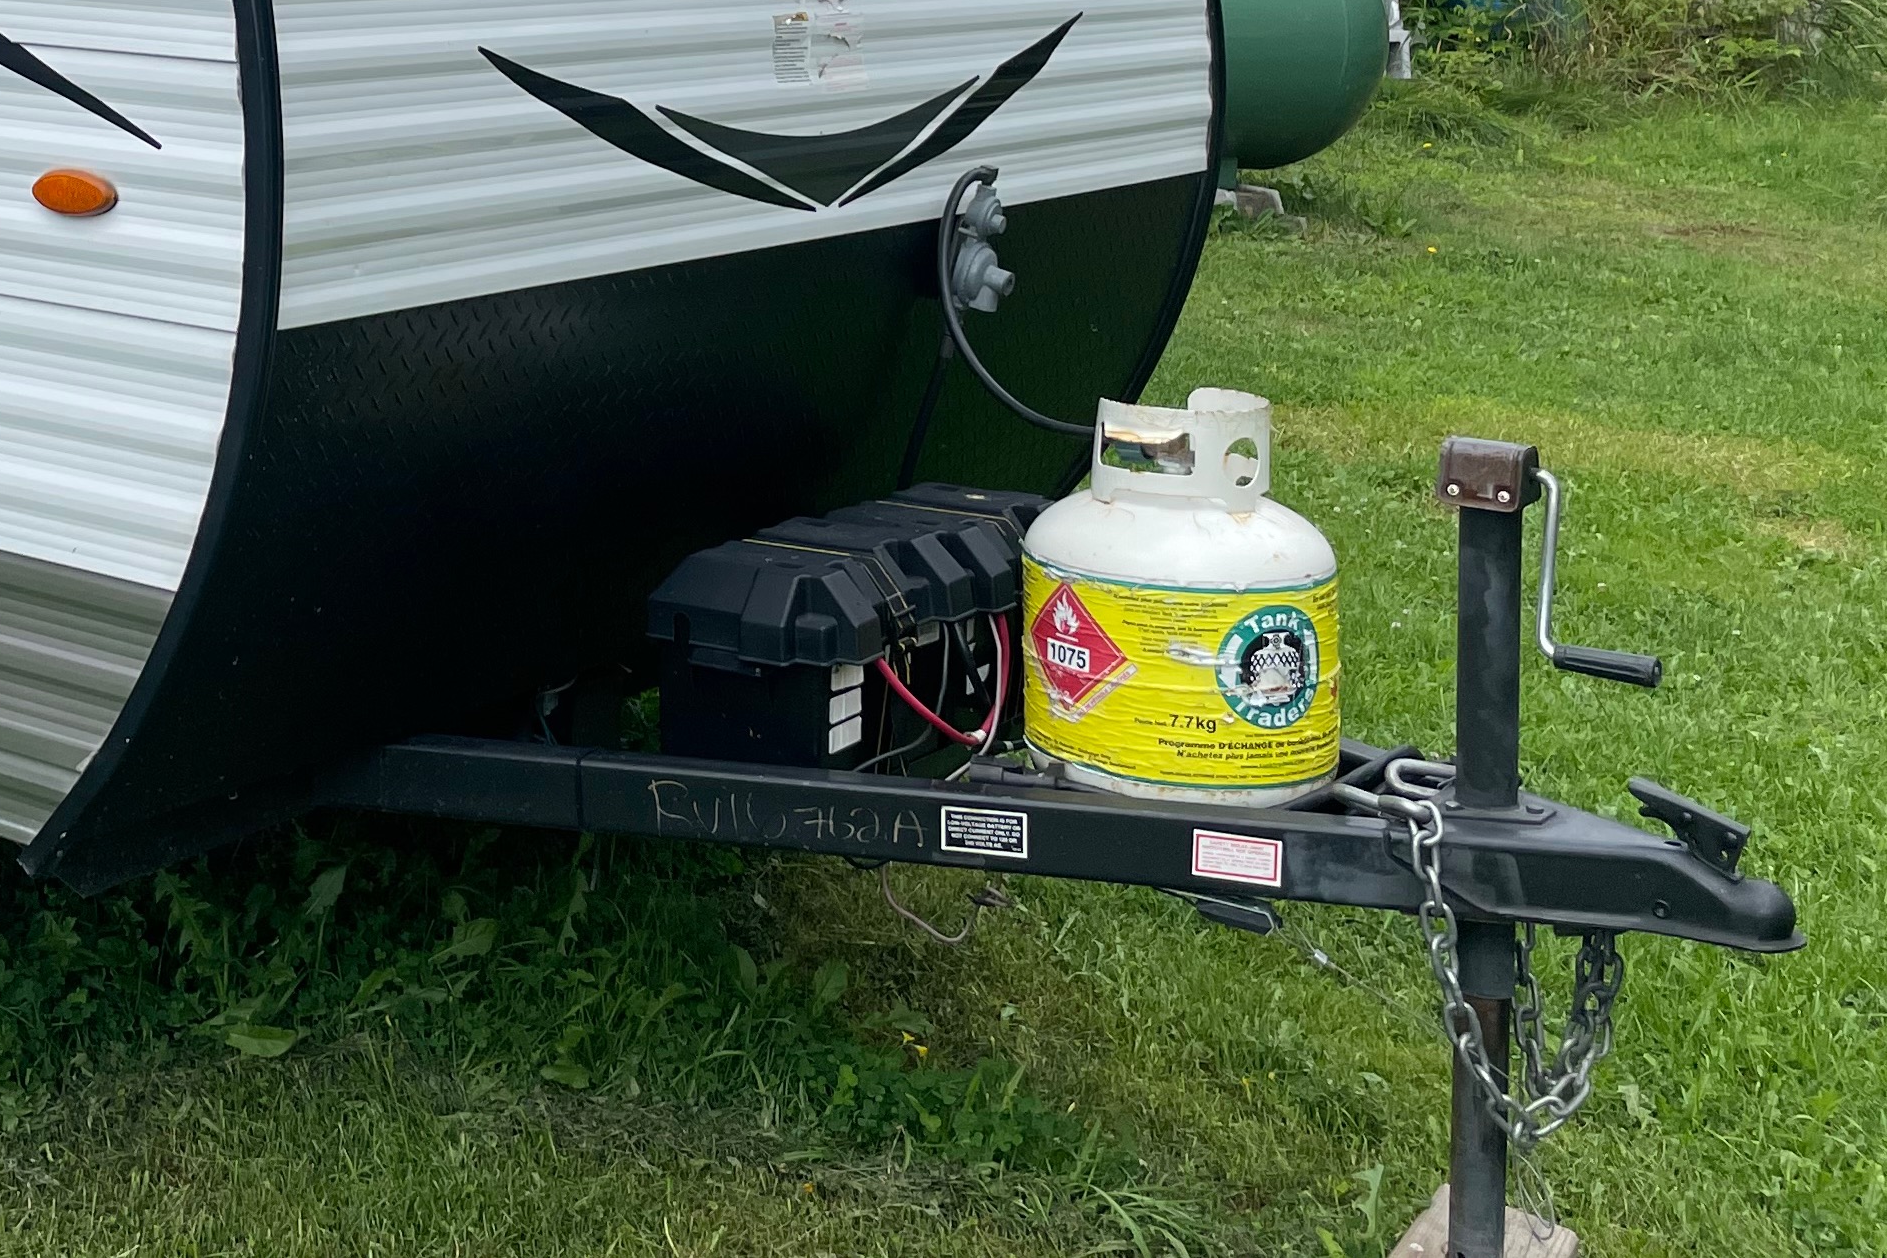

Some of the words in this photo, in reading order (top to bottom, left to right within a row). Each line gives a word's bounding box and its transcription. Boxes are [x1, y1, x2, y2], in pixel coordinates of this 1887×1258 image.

[1244, 611, 1300, 634] Tank
[1050, 642, 1087, 669] 1075
[1234, 687, 1314, 727] Traders
[1158, 738, 1215, 749] Programme
[1225, 752, 1244, 760] plus
[1246, 752, 1273, 760] jamais
